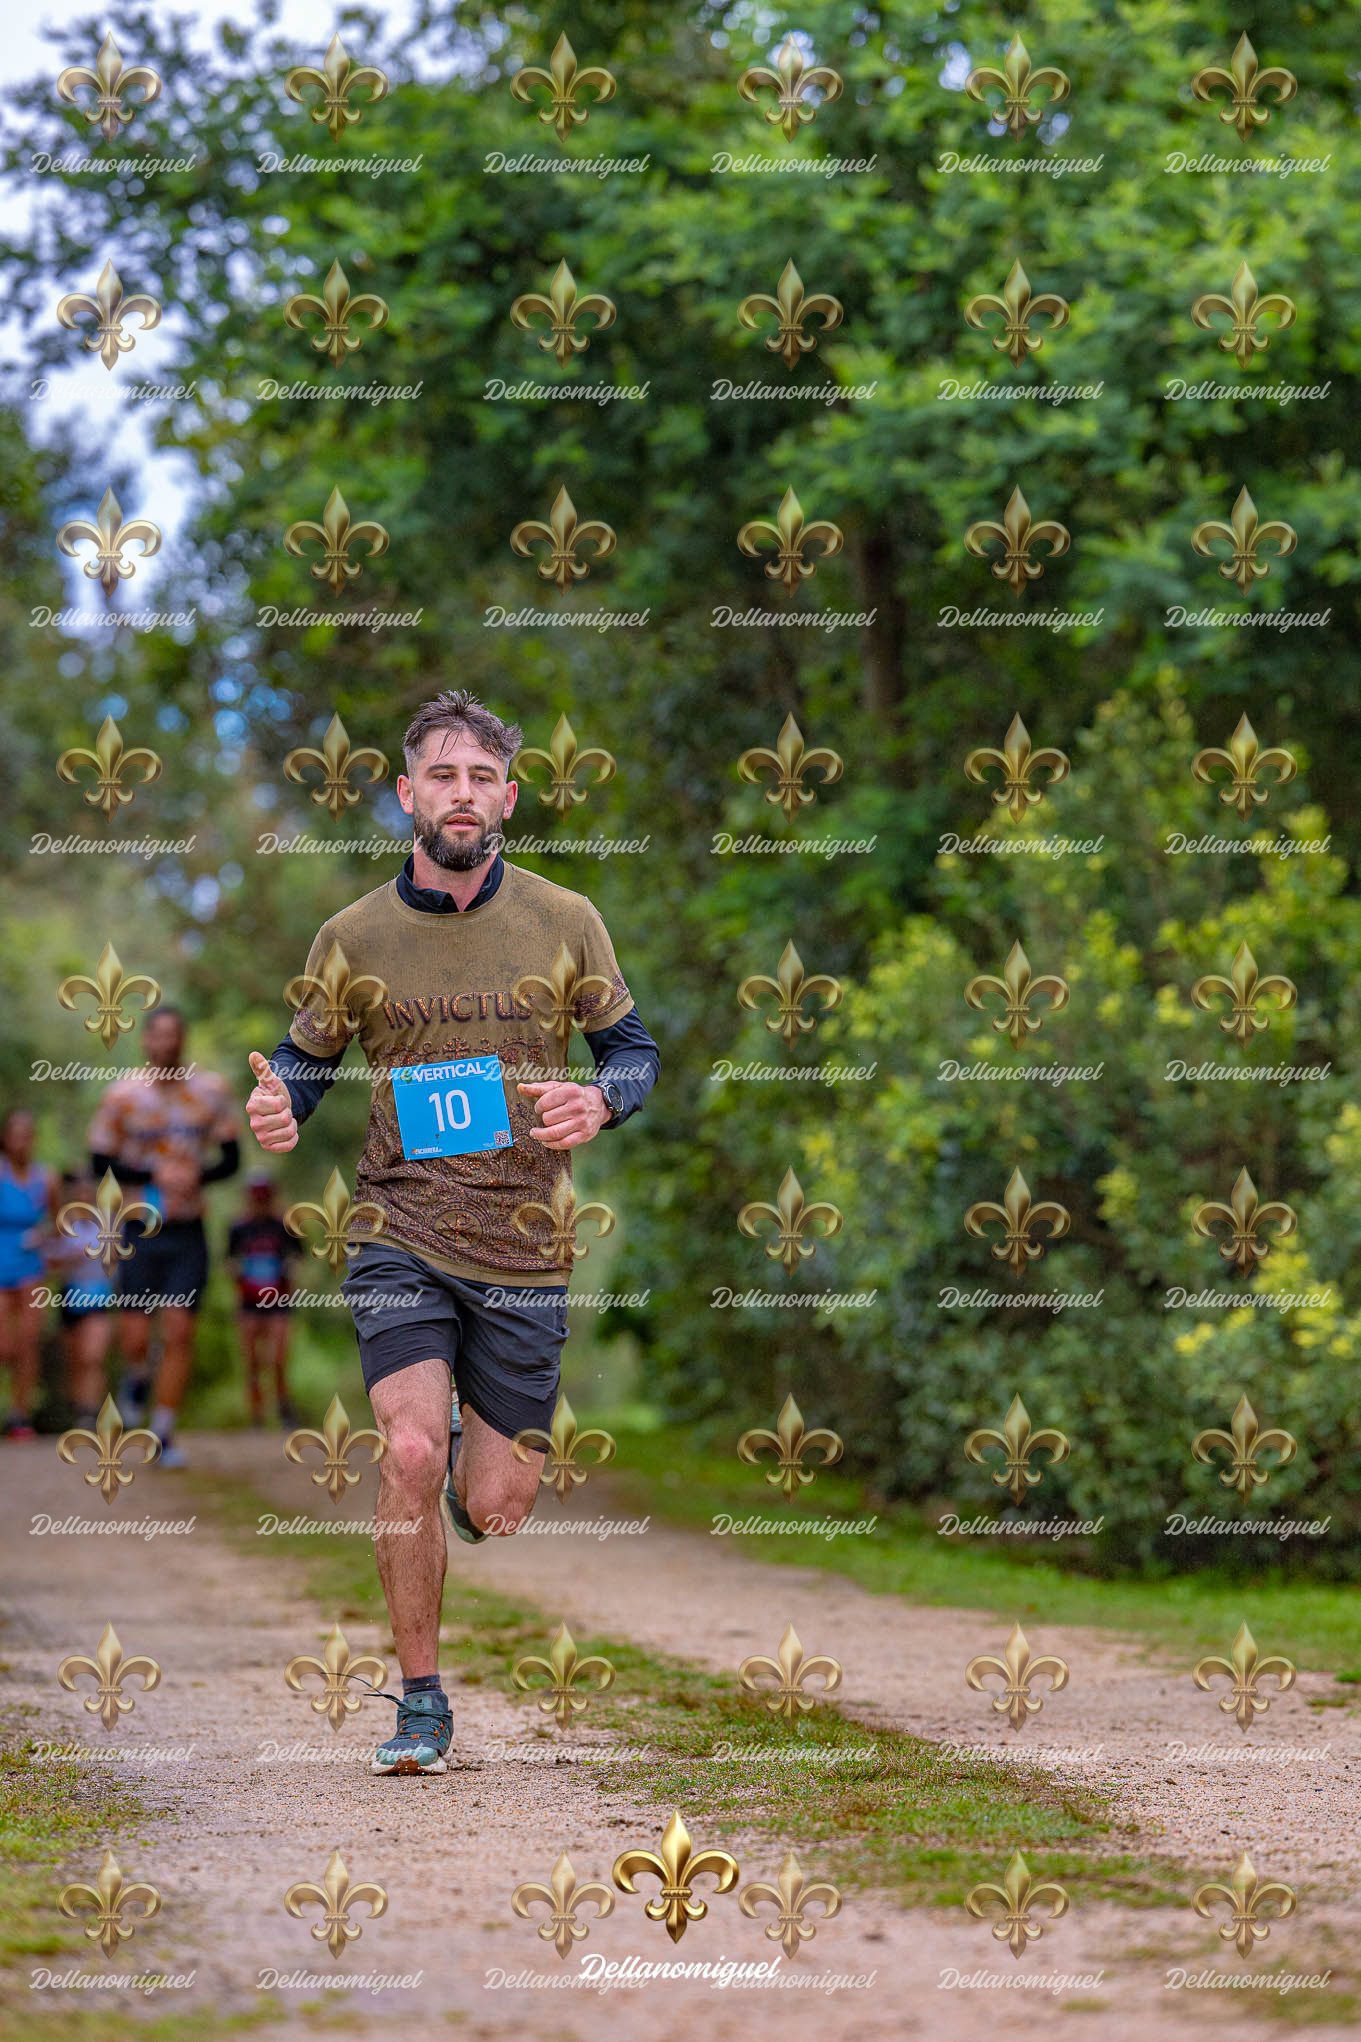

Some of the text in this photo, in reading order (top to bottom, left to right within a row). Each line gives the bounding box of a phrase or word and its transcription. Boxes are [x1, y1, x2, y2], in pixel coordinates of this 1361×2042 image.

[382, 992, 534, 1029] INVICTUS
[413, 1062, 486, 1082] VERTICAL
[428, 1089, 472, 1132] 10
